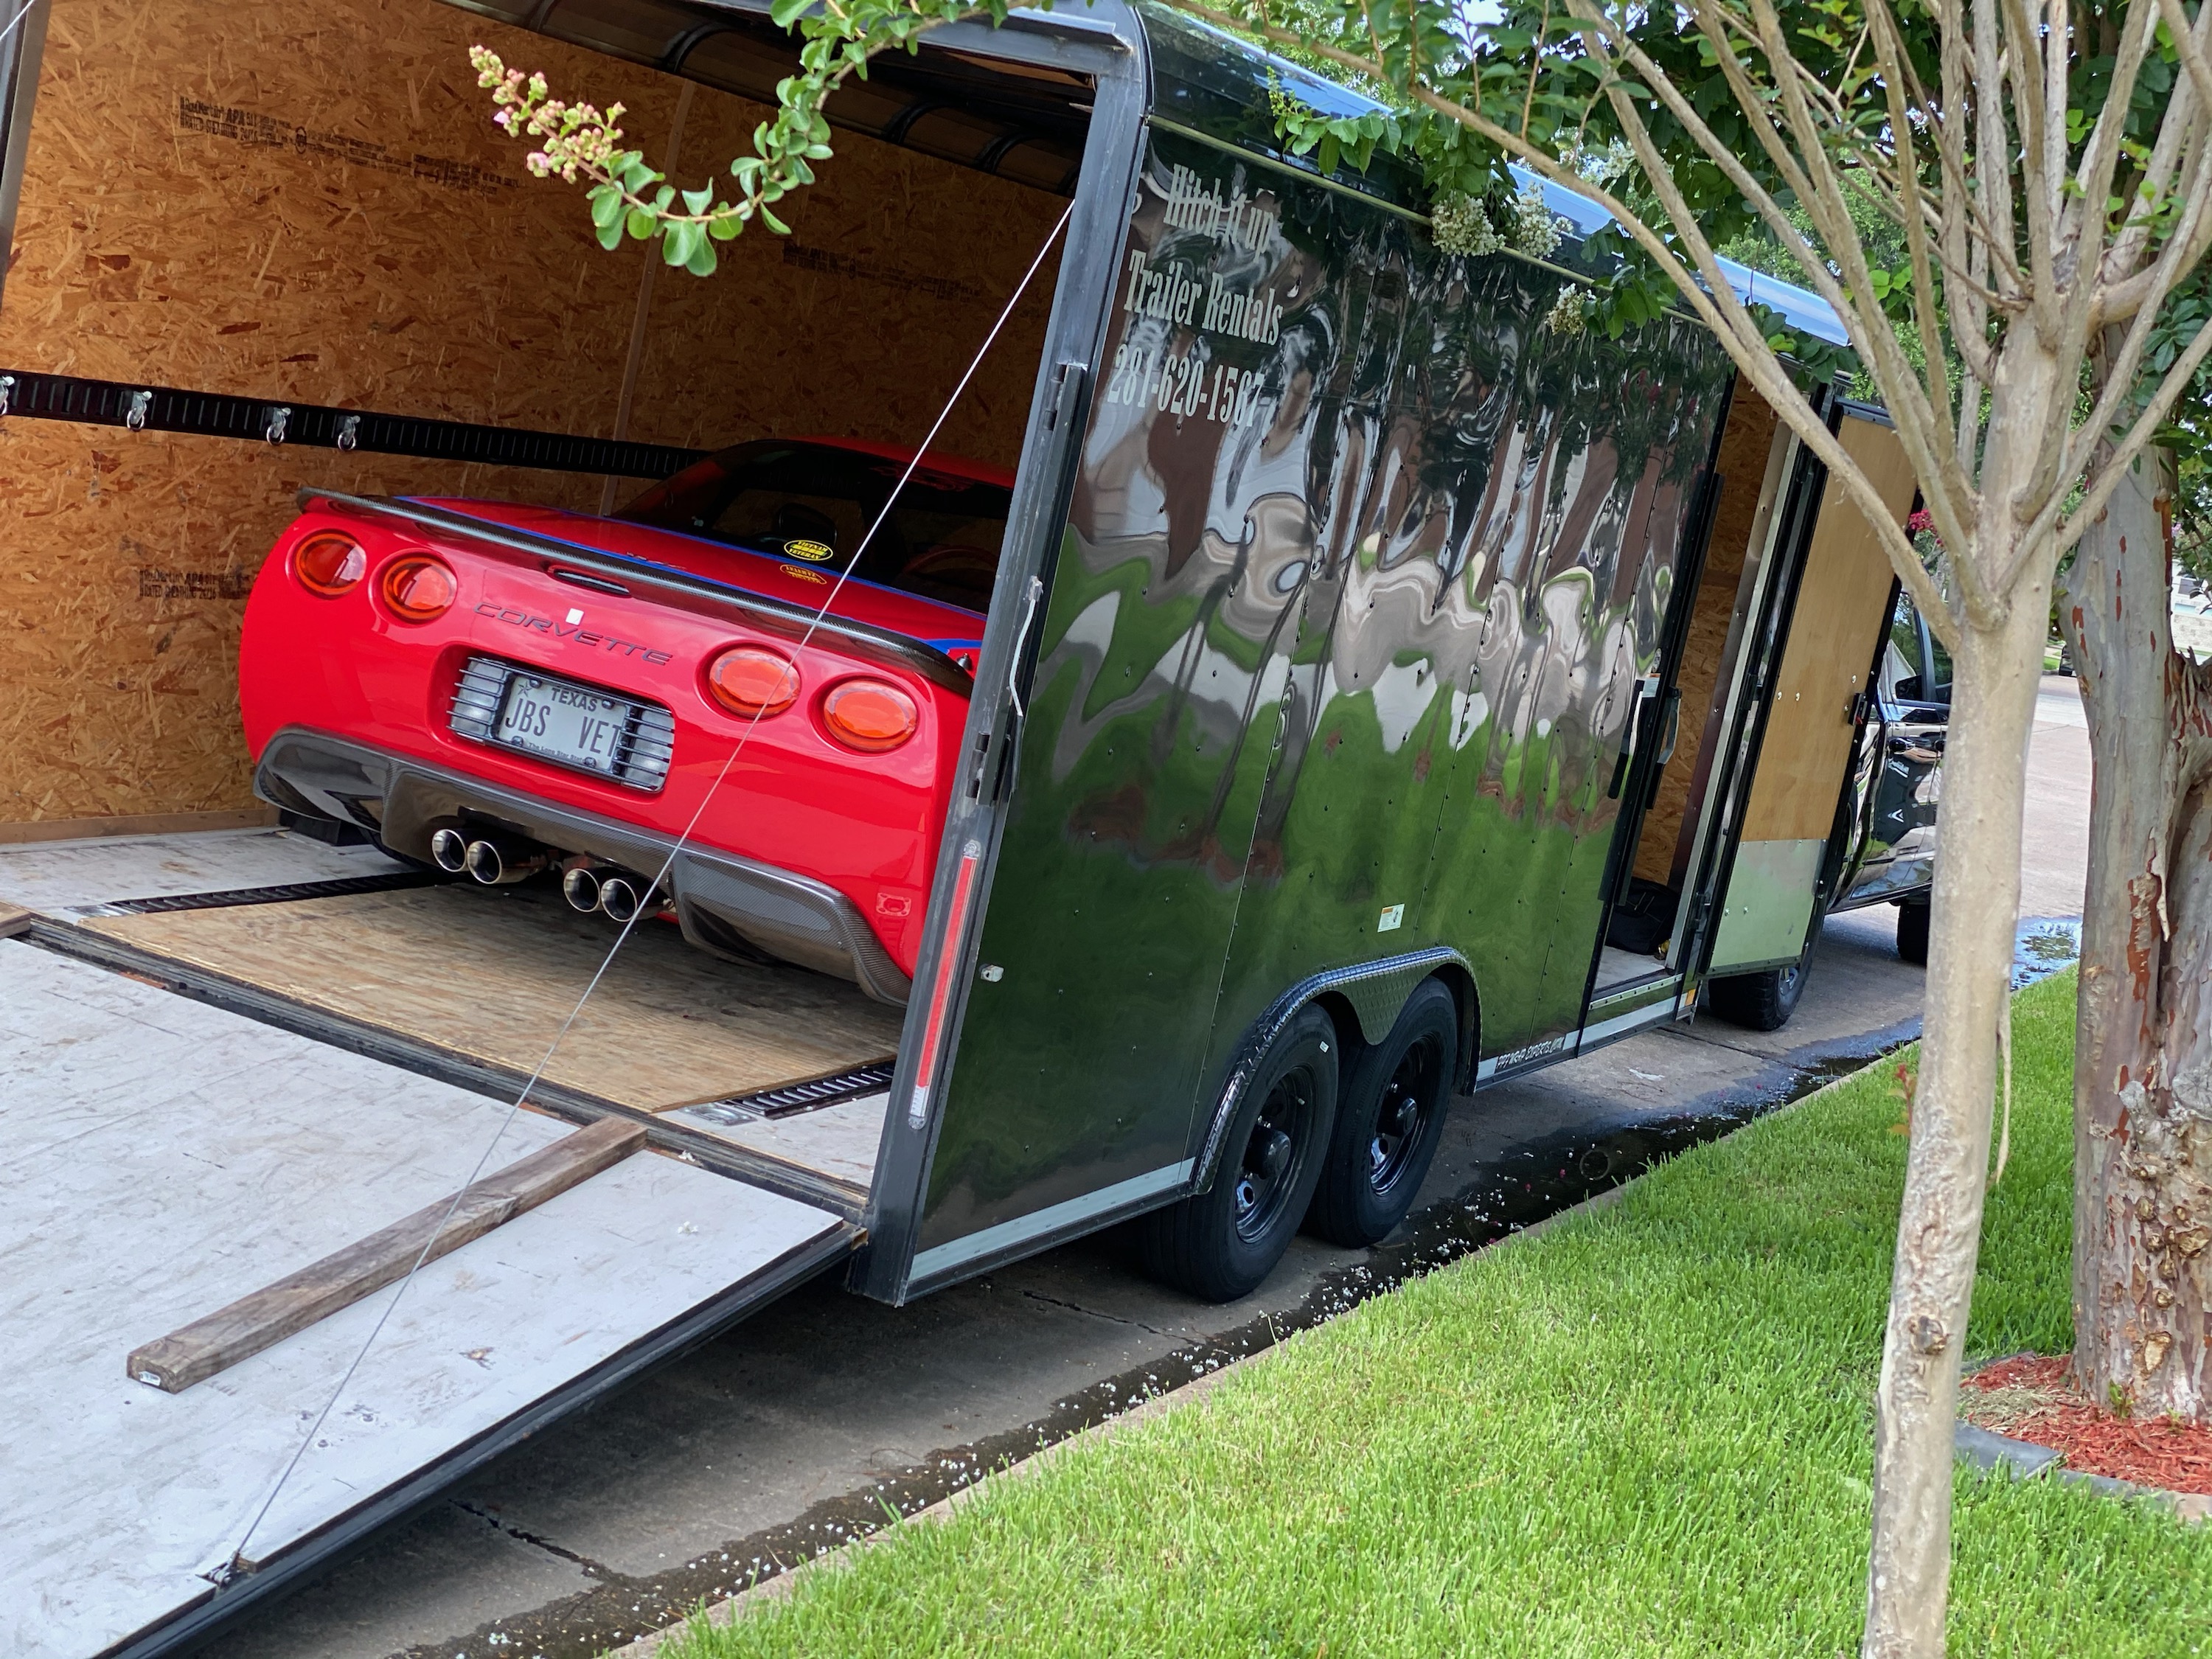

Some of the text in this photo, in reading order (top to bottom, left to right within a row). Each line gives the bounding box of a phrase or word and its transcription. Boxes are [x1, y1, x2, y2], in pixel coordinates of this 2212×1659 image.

[226, 107, 246, 127] APA
[1163, 162, 1275, 262] Hitch it up
[1123, 248, 1284, 346] Trailer Rentals
[1107, 344, 1265, 427] 281-620-1567
[789, 548, 821, 560] VETERAN
[798, 540, 829, 552] VIETNAM
[473, 601, 673, 666] CORVETTE
[552, 687, 599, 712] TEXAS
[504, 698, 623, 758] JBS VET
[529, 742, 540, 750] The
[557, 750, 569, 759] Star
